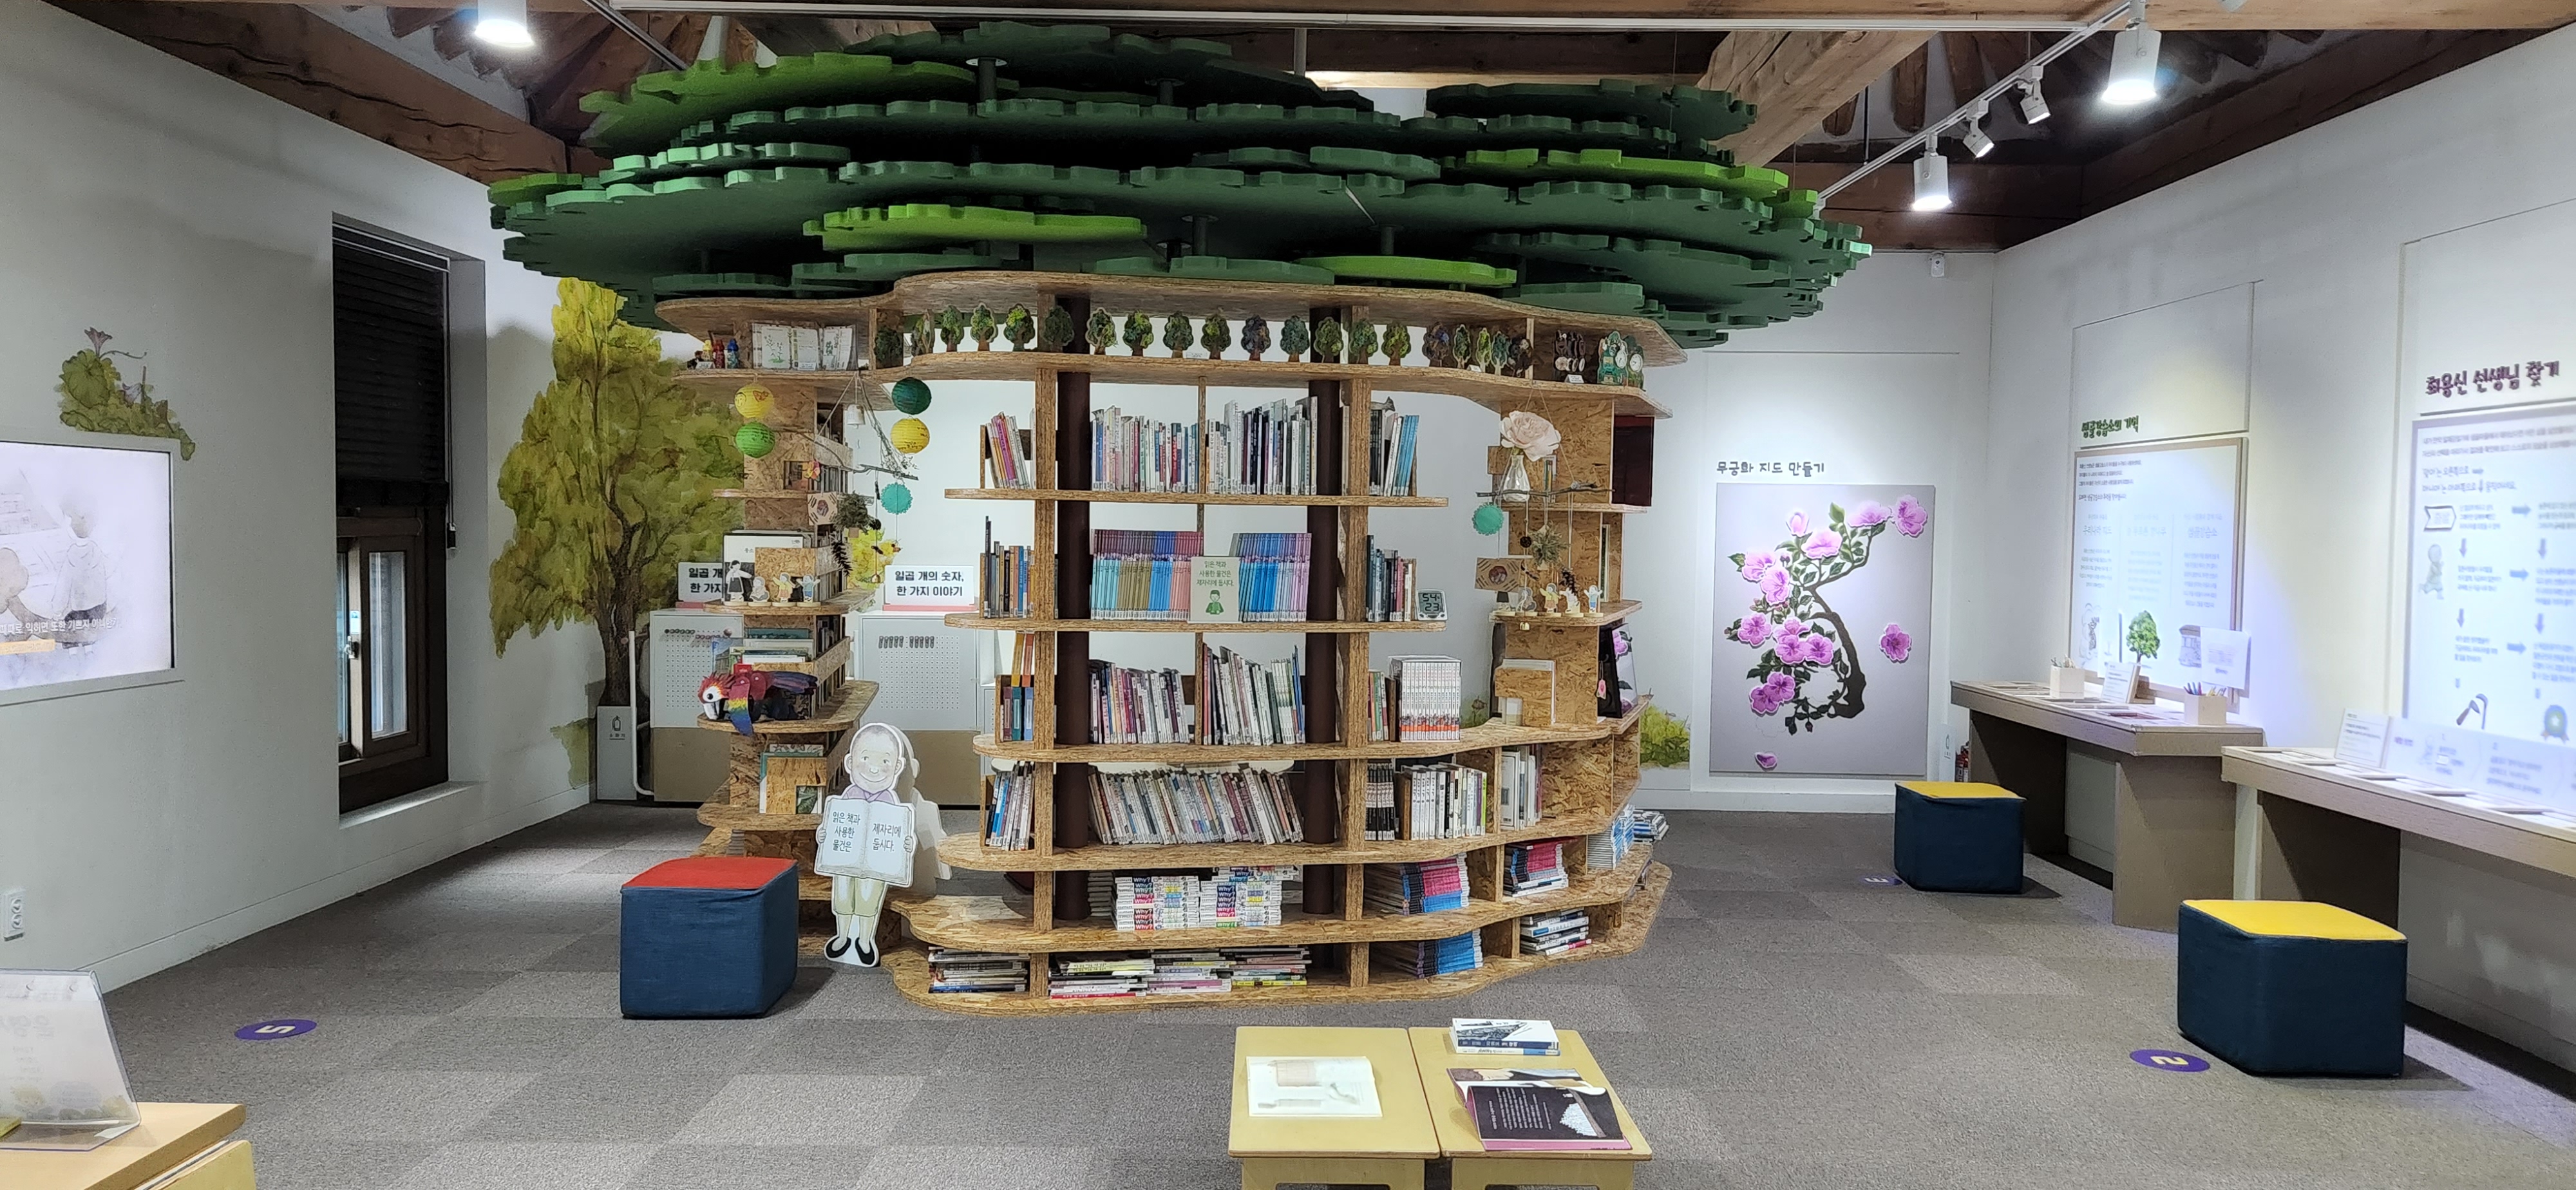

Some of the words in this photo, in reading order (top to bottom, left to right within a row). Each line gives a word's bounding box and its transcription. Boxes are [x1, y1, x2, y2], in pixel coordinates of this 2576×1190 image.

[2425, 370, 2467, 398] 최용신
[2472, 364, 2519, 393] 선생님
[2525, 361, 2560, 388] 찾기
[2123, 415, 2139, 433] 기억
[1716, 461, 1754, 476] 무궁화
[1759, 462, 1783, 473] 지도
[1788, 461, 1824, 477] 만들기
[688, 568, 708, 578] 일곱
[712, 568, 723, 578] 개
[895, 571, 914, 581] 일곱
[918, 571, 938, 581] 개의
[942, 571, 964, 582] 숫자,
[690, 583, 701, 593] 한
[896, 586, 907, 596] 한
[909, 586, 929, 596] 가지
[933, 586, 963, 596] 이야기
[1425, 603, 1439, 611] 23
[25, 622, 48, 633] 익히면
[51, 621, 66, 632] 또한
[833, 811, 845, 824] 읽은
[846, 813, 860, 825] 책과
[835, 826, 855, 839] 사용한
[872, 823, 902, 838] 제자리에
[833, 839, 852, 853] 물건은
[873, 838, 895, 852] 둡시다.
